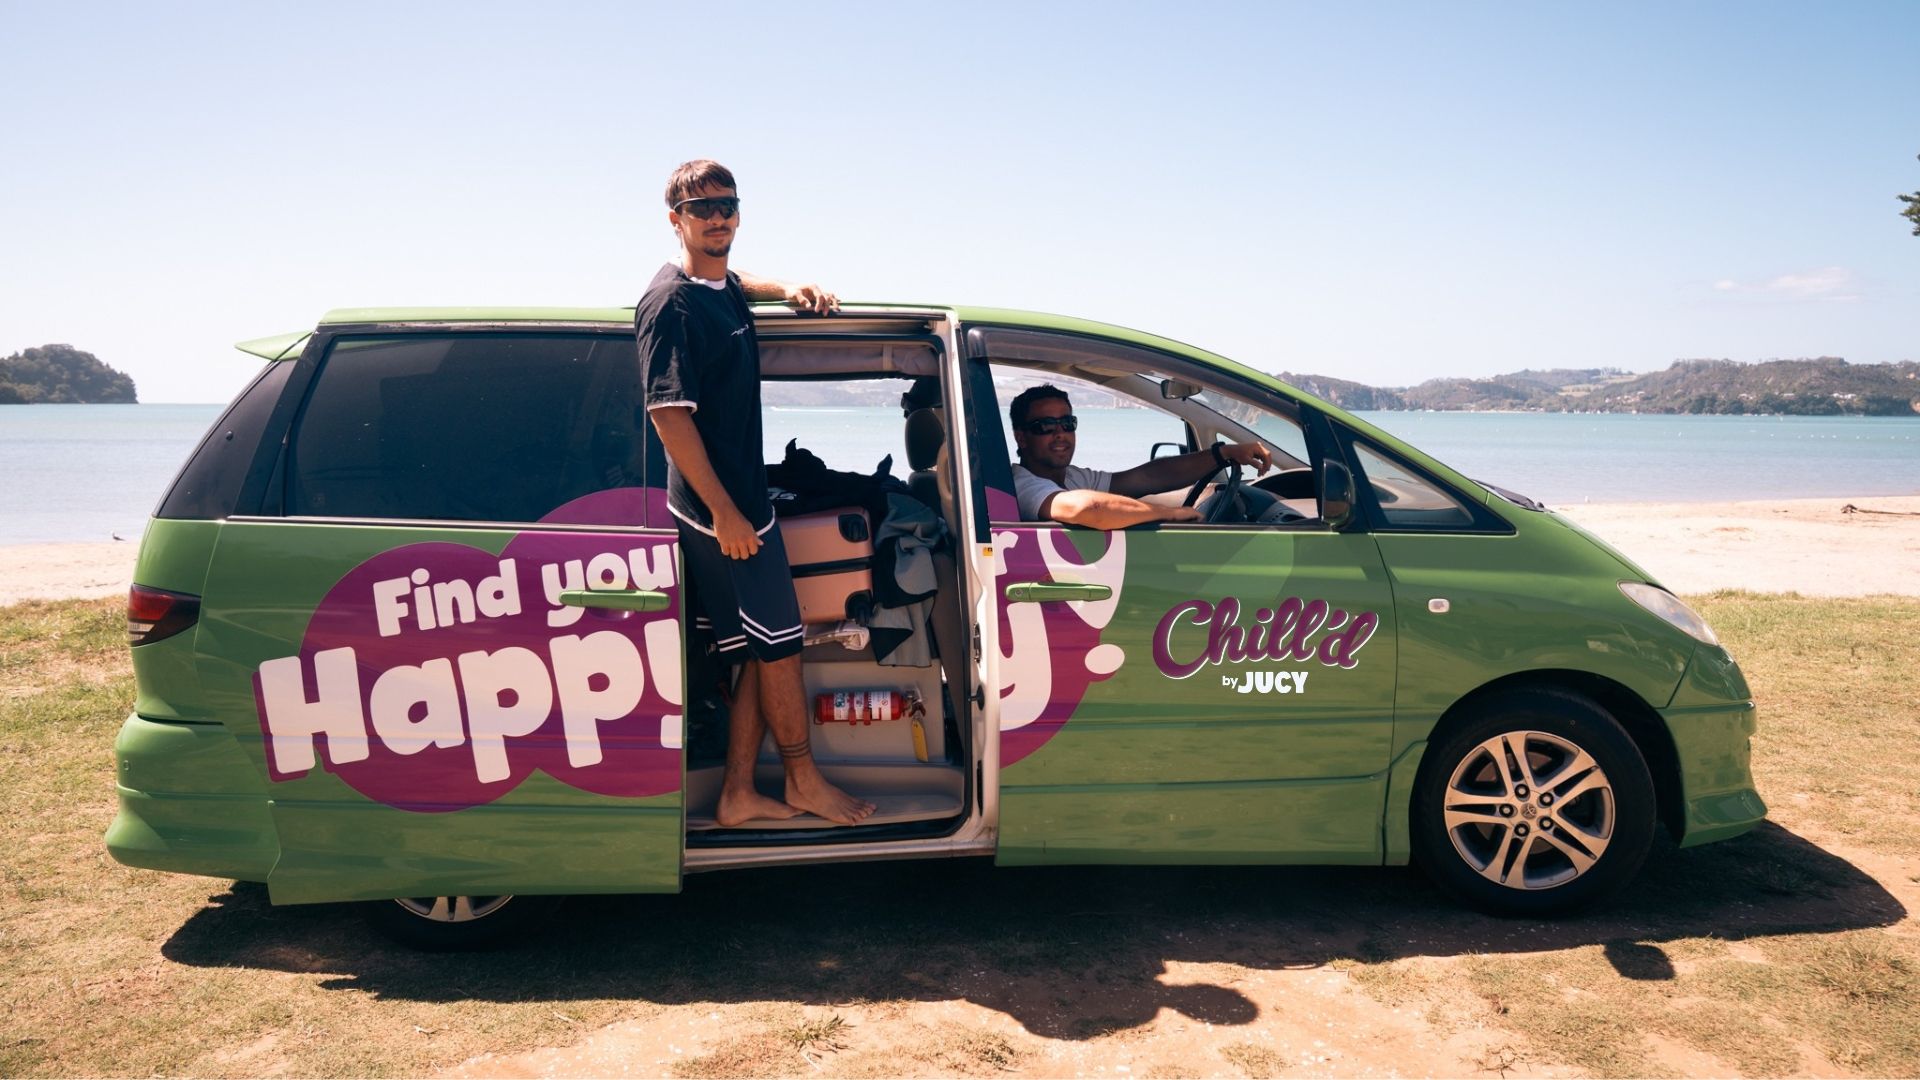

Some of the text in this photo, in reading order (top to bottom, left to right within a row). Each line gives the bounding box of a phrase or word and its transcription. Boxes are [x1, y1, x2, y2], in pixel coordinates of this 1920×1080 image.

[373, 542, 680, 637] Find you
[1153, 596, 1379, 680] Chill'd
[1222, 671, 1309, 694] by JUCY
